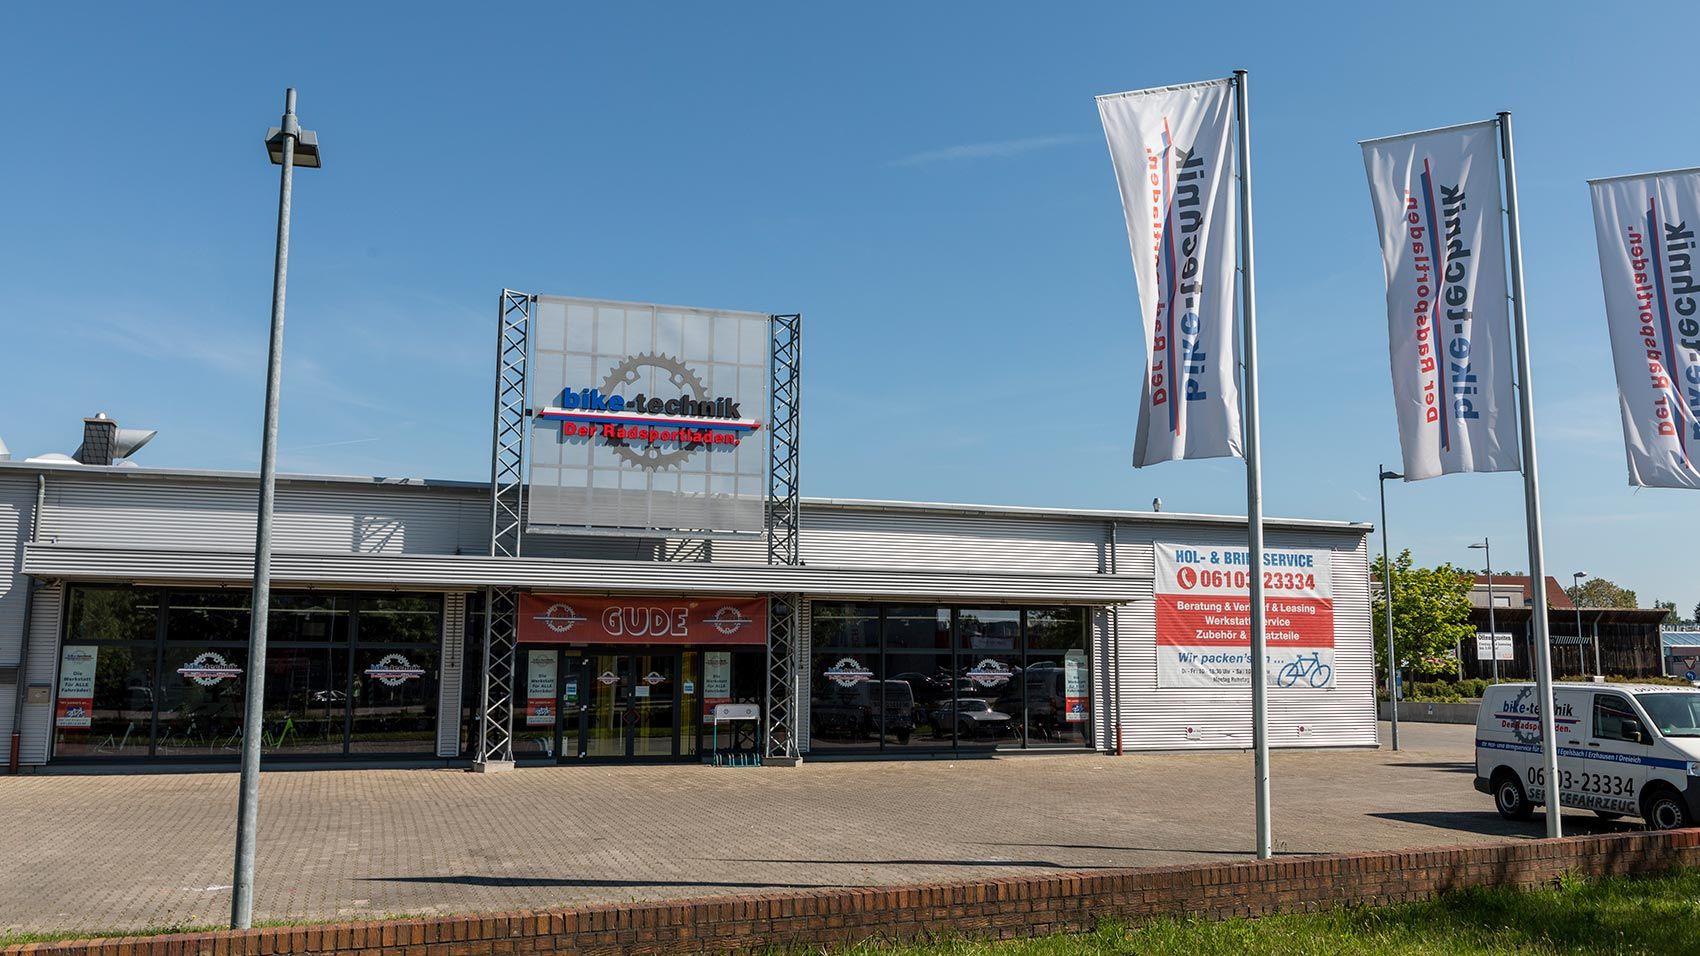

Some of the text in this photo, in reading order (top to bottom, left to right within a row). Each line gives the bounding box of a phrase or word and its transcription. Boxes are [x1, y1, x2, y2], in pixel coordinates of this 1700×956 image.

[563, 387, 742, 419] bike-technik
[564, 421, 596, 437] Der
[1175, 550, 1206, 563] HOL-
[1210, 551, 1220, 564] &
[1177, 601, 1316, 614] Beratung & Verf & Leasing
[601, 606, 688, 636] GUDE
[1196, 629, 1237, 639] Zubehör
[1240, 630, 1247, 639] &
[1178, 652, 1198, 663] Wir
[1503, 700, 1574, 716] bike-tenik
